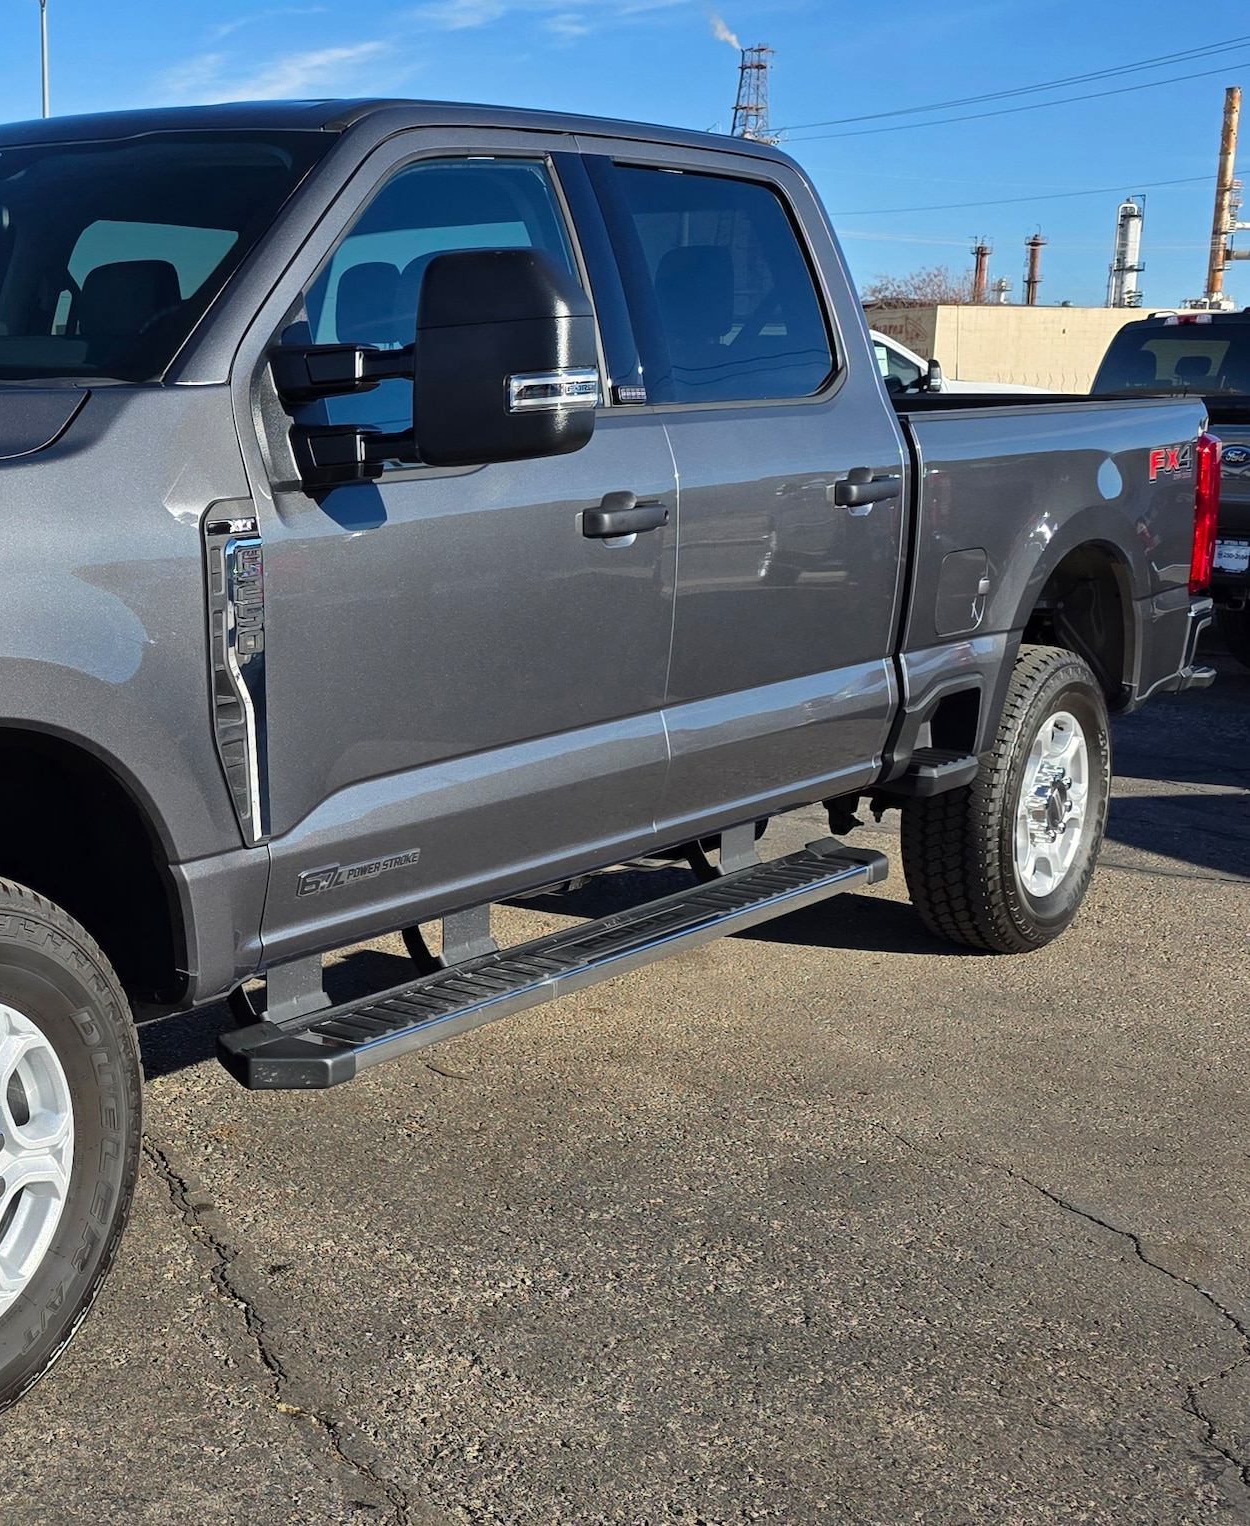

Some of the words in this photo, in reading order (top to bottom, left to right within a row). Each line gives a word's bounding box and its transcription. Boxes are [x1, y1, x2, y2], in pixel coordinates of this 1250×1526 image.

[1149, 443, 1192, 483] FX4
[1225, 449, 1247, 462] Ford
[347, 862, 380, 880] POWER
[381, 851, 419, 871] STROKE
[68, 1005, 120, 1275] DUELER
